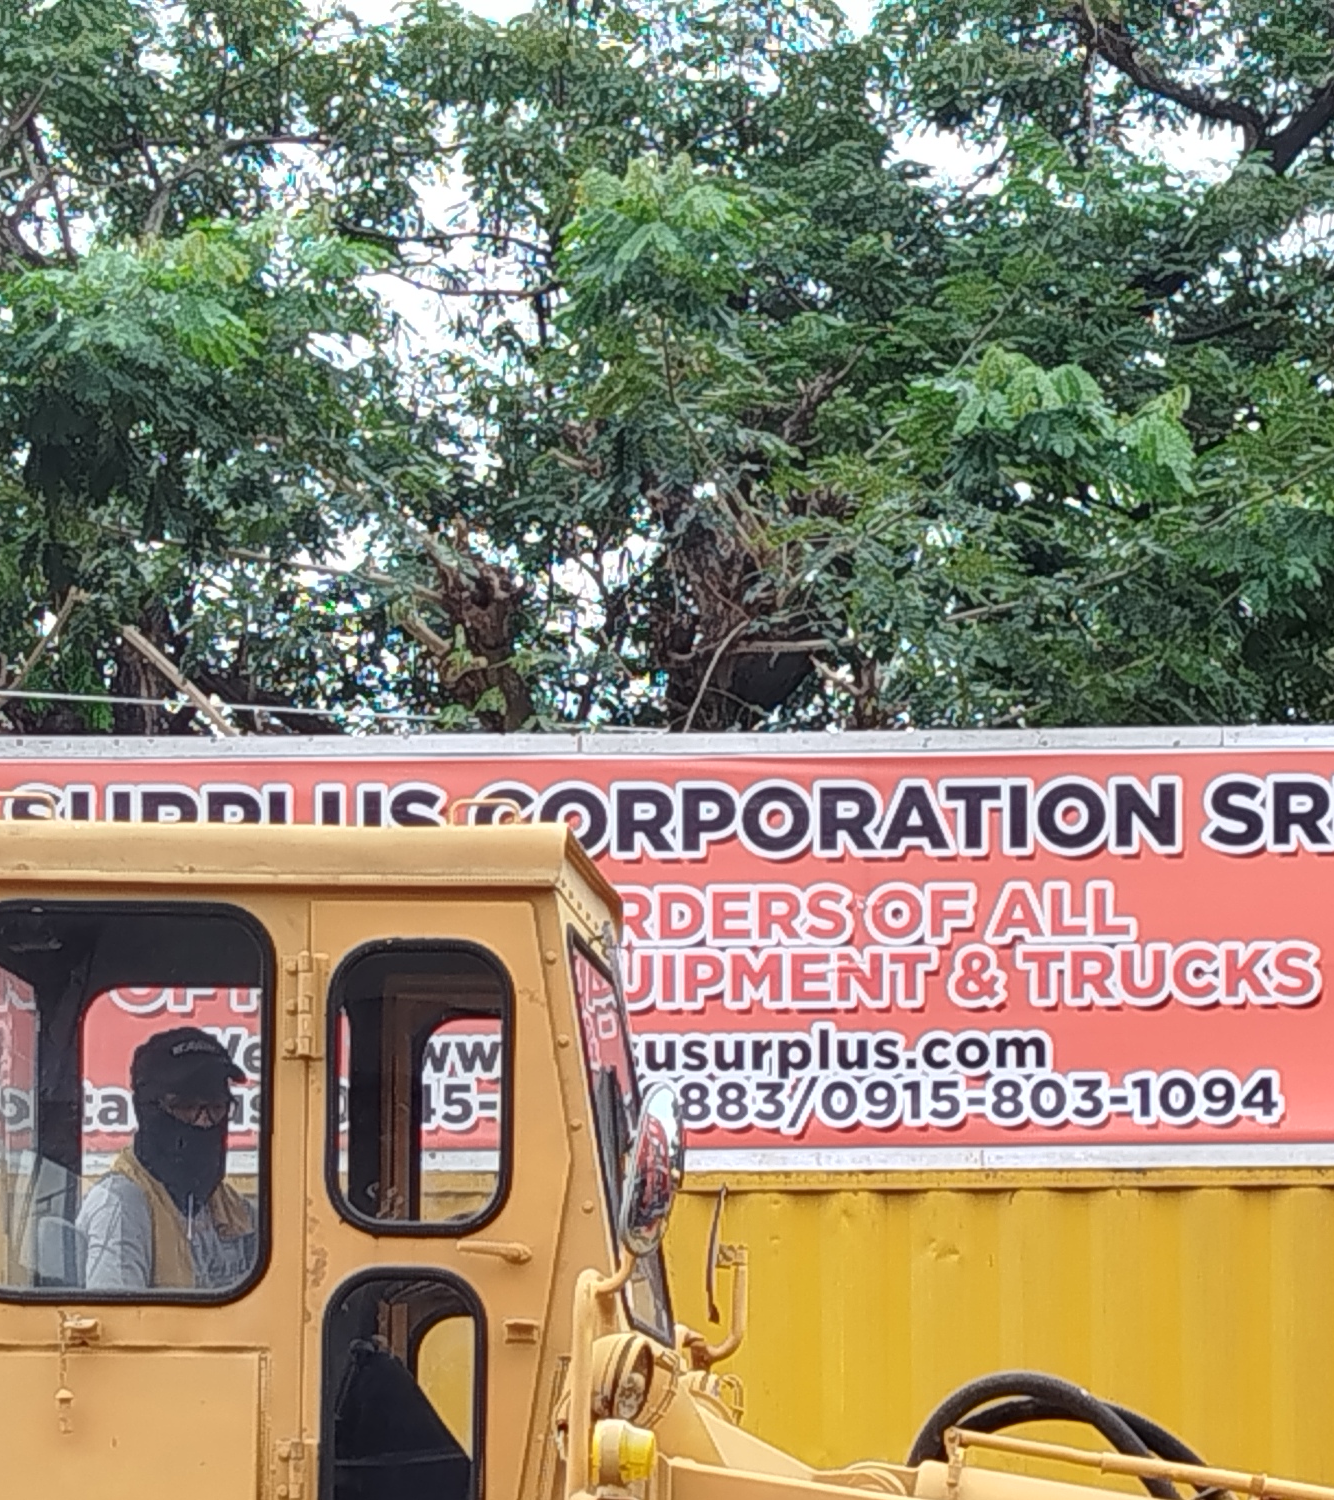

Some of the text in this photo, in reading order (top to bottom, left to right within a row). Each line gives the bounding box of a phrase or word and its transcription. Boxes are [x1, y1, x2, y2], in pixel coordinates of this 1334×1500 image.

[470, 780, 1180, 855] CORPORATION
[622, 884, 1132, 942] RDERS OF ALL
[625, 945, 1317, 1004] UIPMENT & TRUCKS
